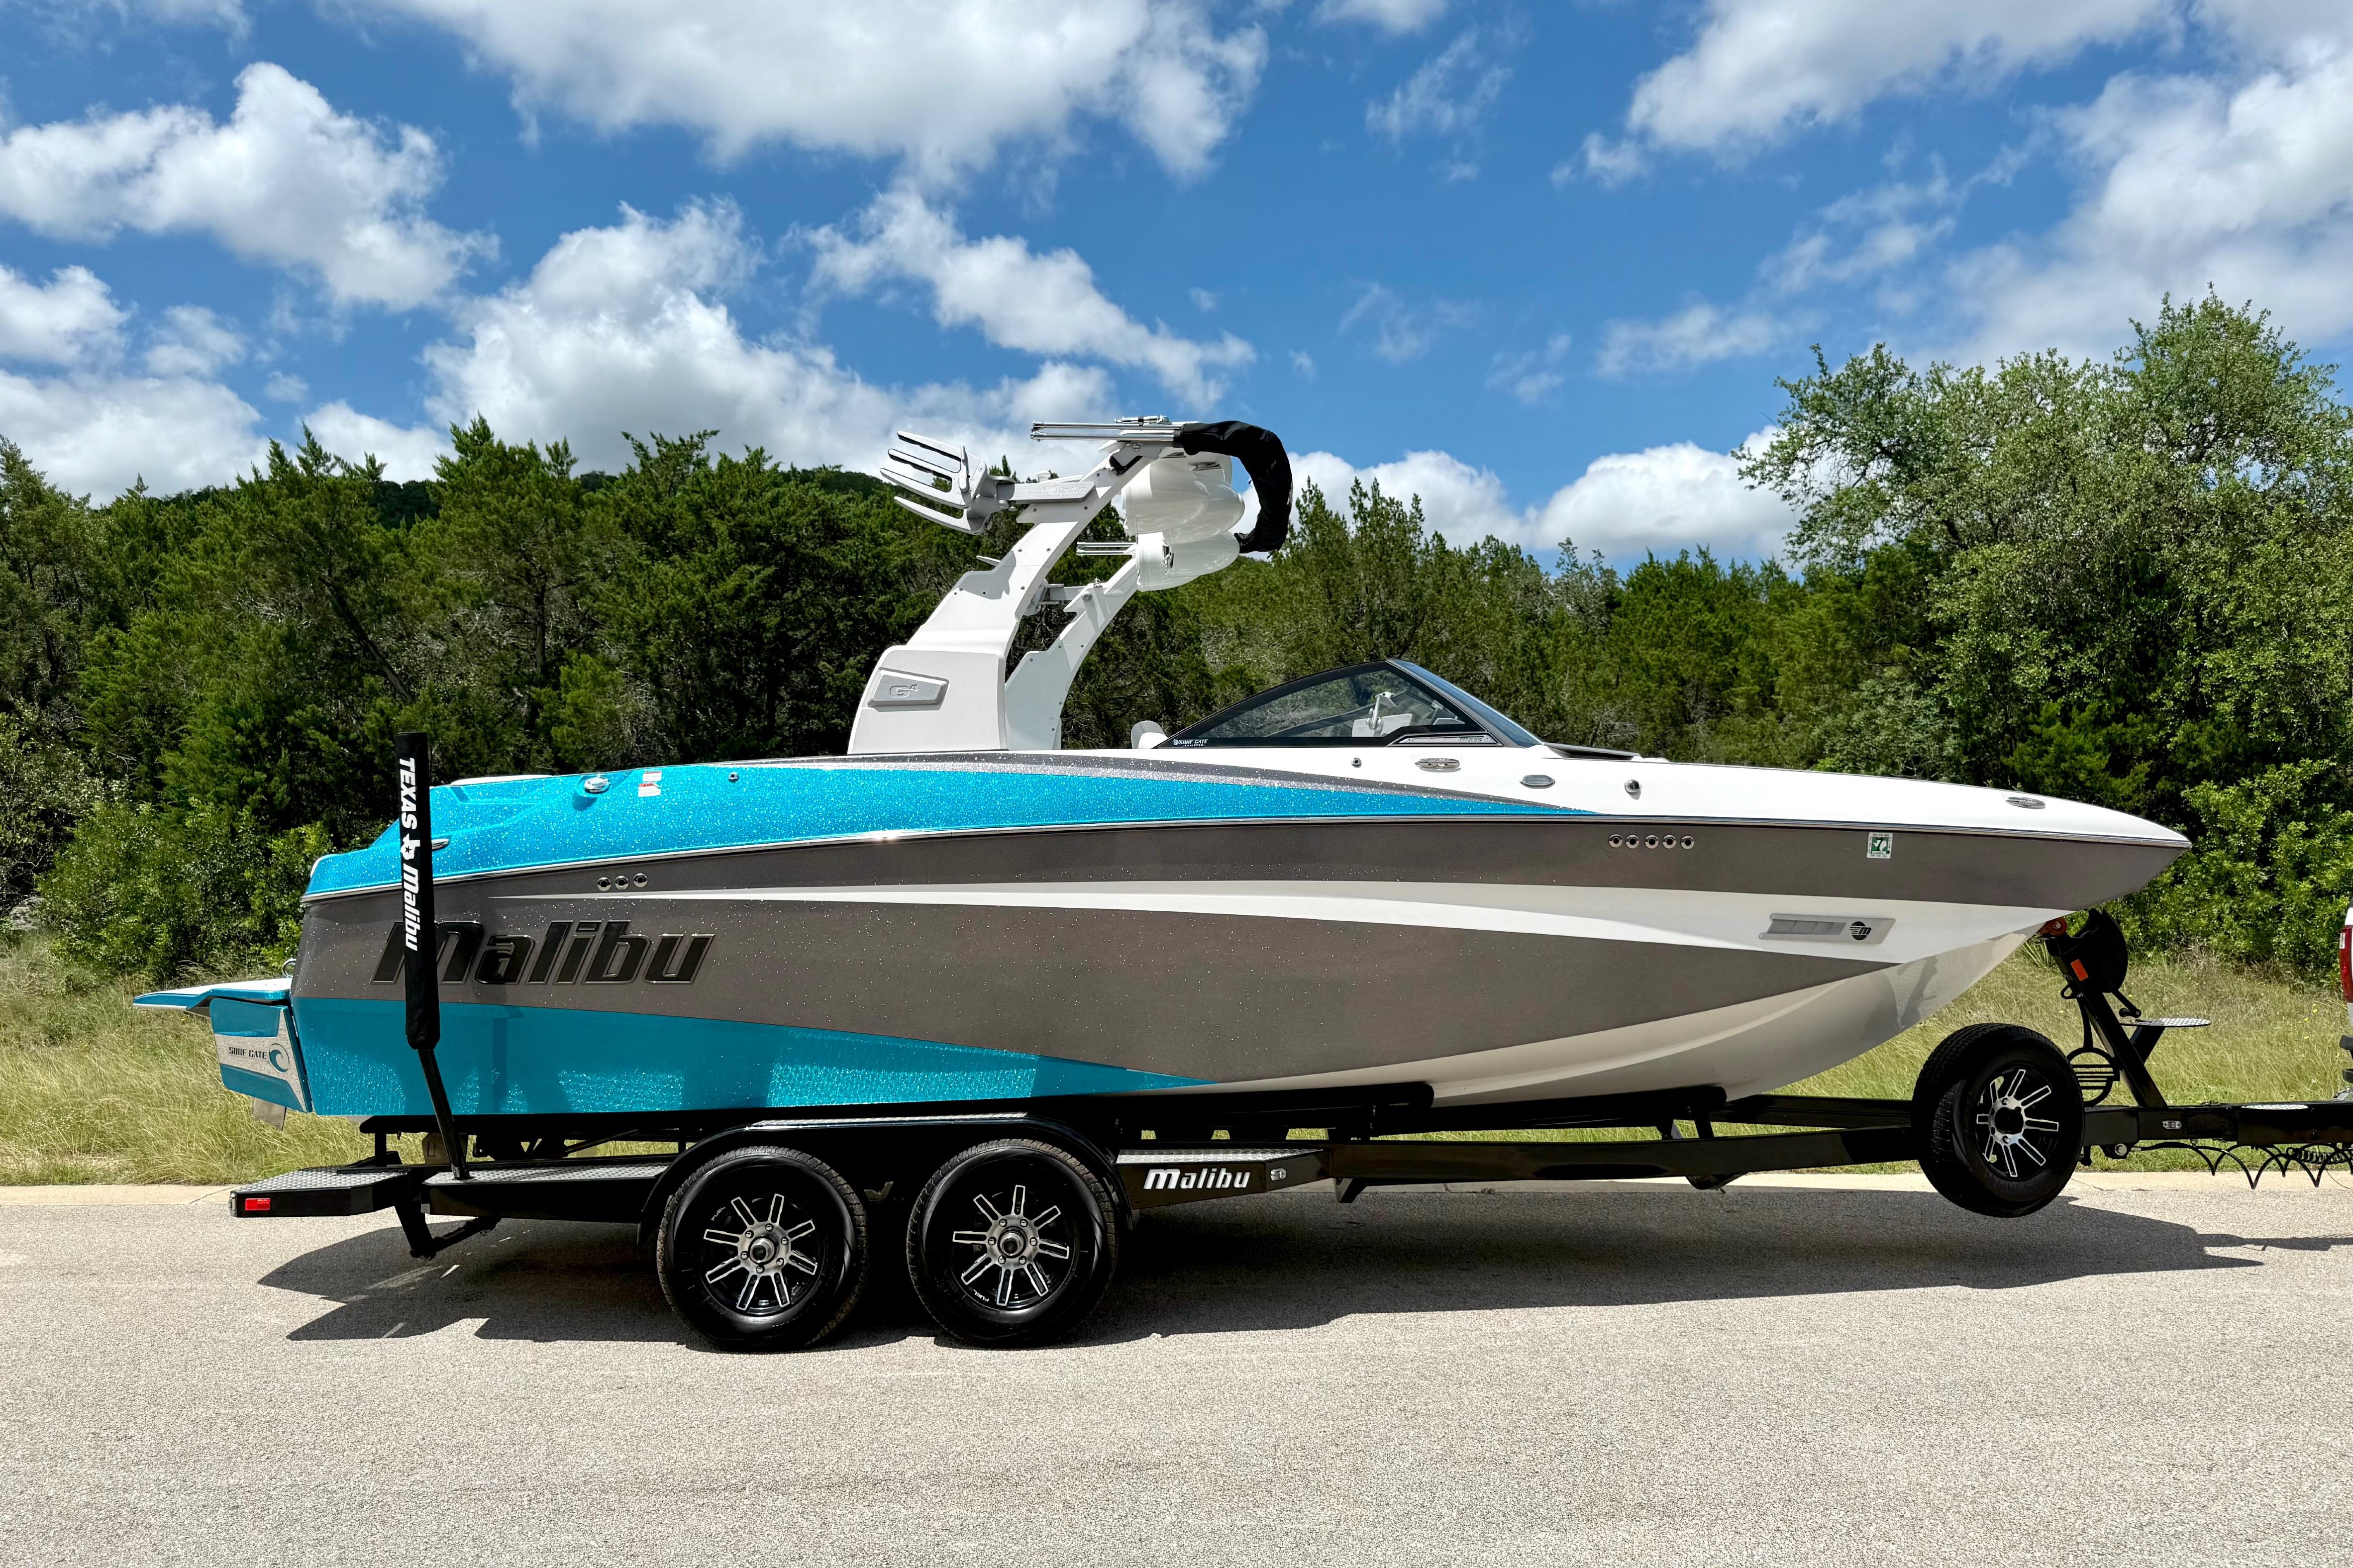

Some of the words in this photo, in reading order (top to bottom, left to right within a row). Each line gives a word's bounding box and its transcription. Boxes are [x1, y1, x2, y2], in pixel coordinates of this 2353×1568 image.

[400, 758, 417, 830] TEXAS
[403, 863, 420, 951] Malibu
[370, 920, 715, 985] Malibu
[229, 1047, 246, 1056] SURF
[249, 1050, 267, 1059] GATE
[1143, 1168, 1250, 1189] Malibu
[711, 1206, 725, 1221] FUEL
